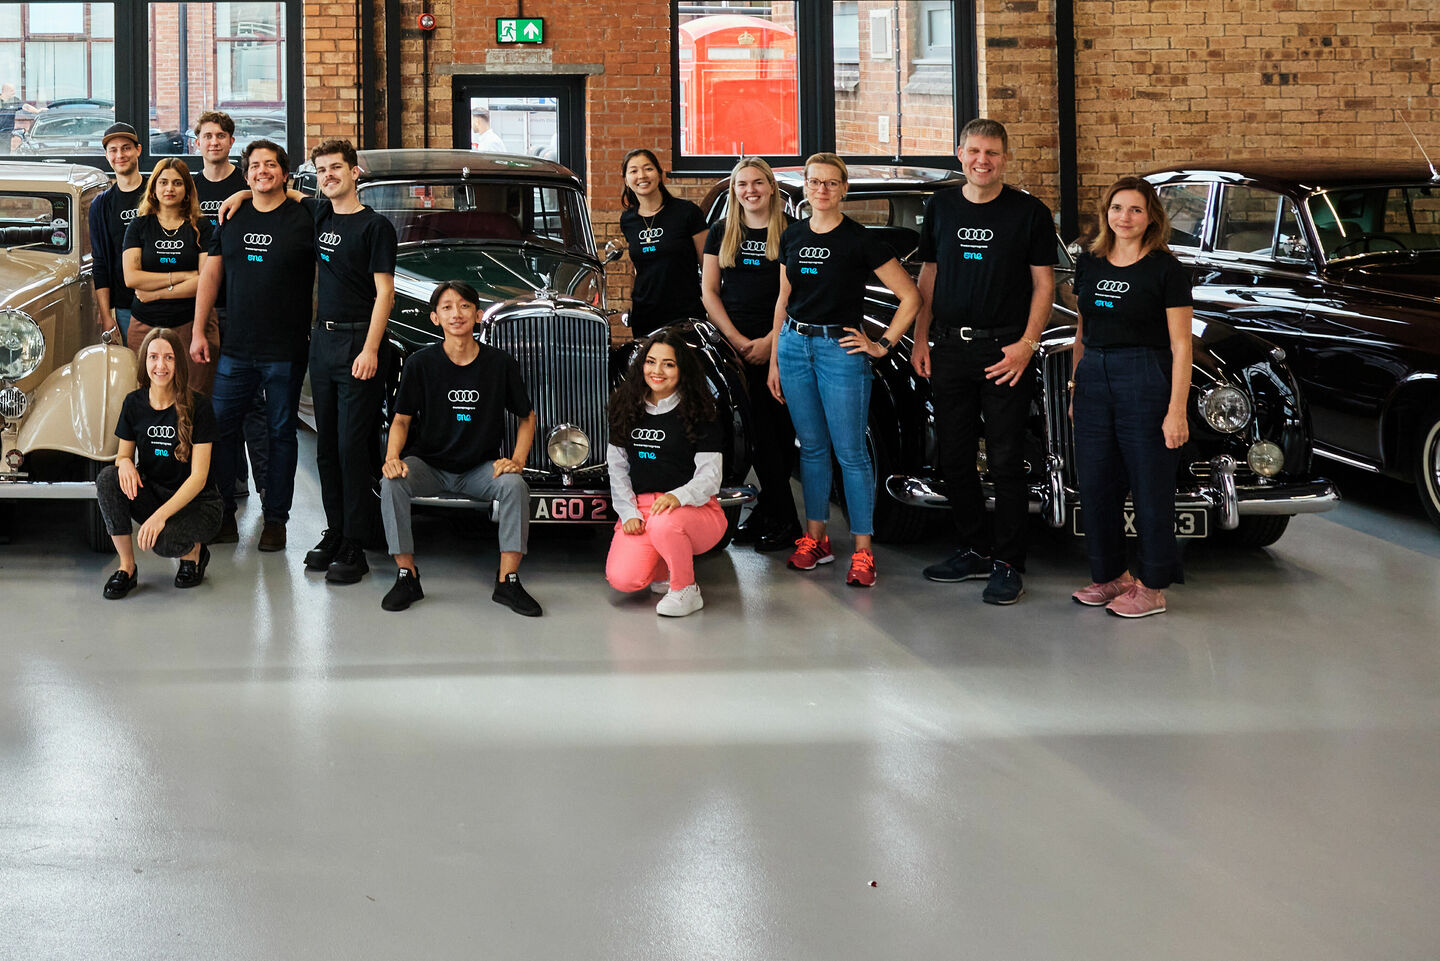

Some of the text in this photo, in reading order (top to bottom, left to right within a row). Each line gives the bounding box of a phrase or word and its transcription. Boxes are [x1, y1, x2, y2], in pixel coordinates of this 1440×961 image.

[963, 251, 983, 260] one
[638, 450, 657, 459] one
[535, 497, 608, 520] AGO 2
[1174, 512, 1195, 534] 3
